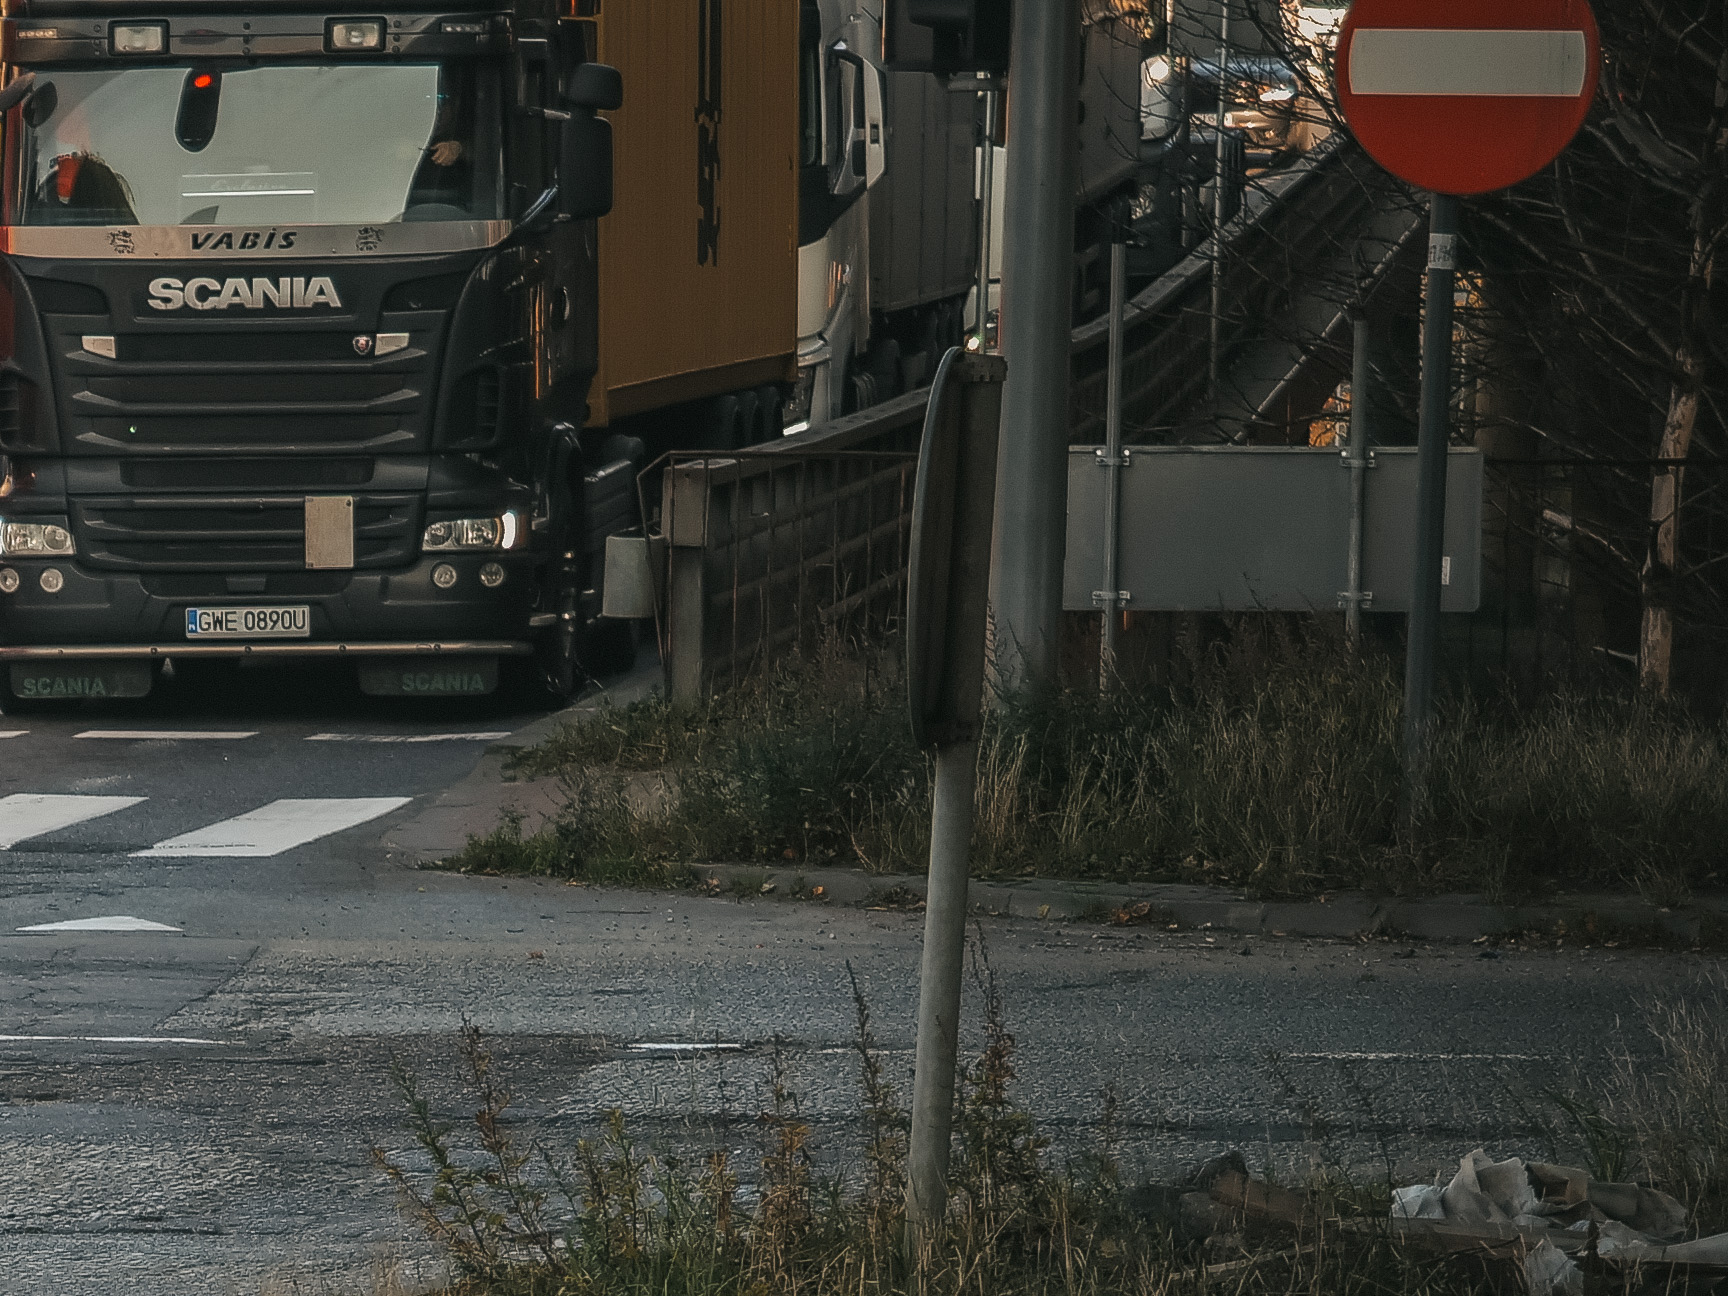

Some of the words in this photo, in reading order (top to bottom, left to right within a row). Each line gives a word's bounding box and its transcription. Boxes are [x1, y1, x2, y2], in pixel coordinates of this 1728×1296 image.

[147, 276, 342, 310] SCANIA
[198, 611, 238, 632] GWE
[244, 609, 306, 631] 0890U
[23, 677, 105, 696] SCANIA
[401, 673, 485, 692] SCANIA
